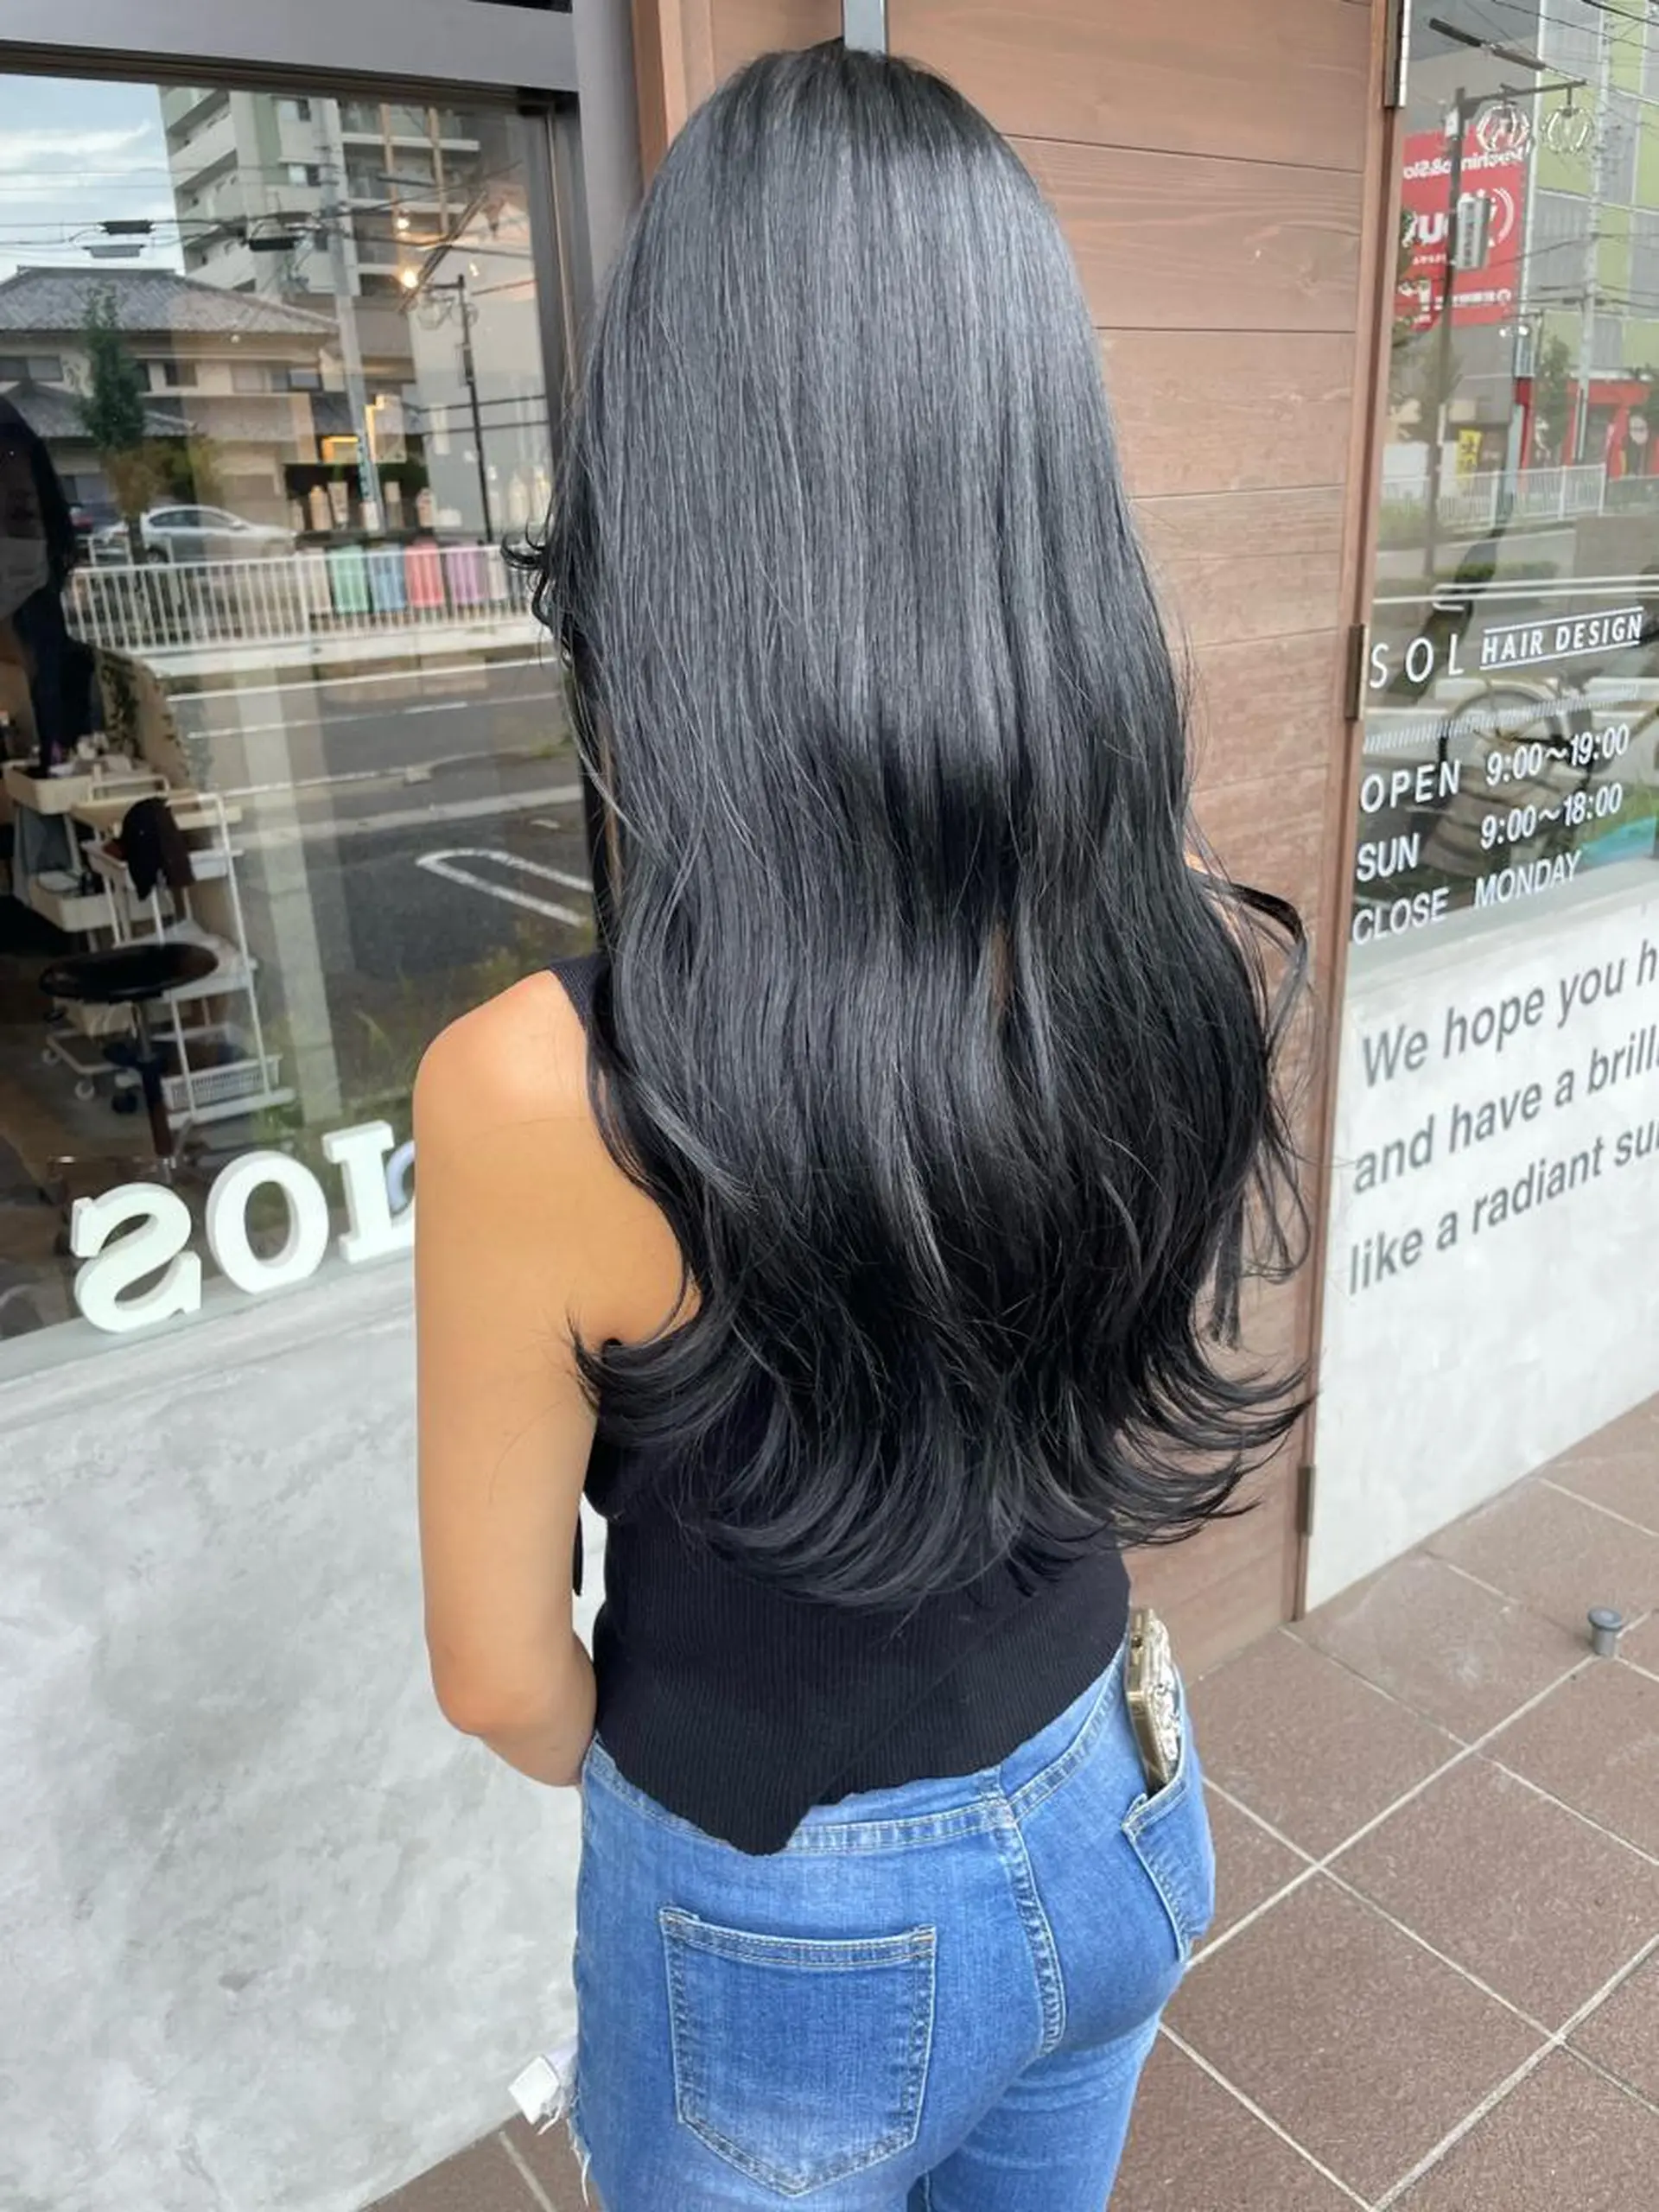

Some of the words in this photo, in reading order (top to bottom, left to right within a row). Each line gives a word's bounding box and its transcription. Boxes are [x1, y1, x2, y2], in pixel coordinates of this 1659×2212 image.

[1370, 634, 1464, 689] SOL
[1482, 630, 1543, 664] HAIR
[1555, 613, 1643, 652] DESIGN
[1360, 759, 1460, 813] OPEN
[1352, 886, 1449, 945] CLOSE
[1474, 849, 1582, 909] MONDAY
[1357, 832, 1420, 882] SUN
[1363, 1024, 1428, 1088] We
[1443, 987, 1545, 1058] hope
[1557, 957, 1625, 1028] you
[1354, 1114, 1434, 1194] and
[1449, 1083, 1542, 1154] have
[1554, 1069, 1574, 1108] a
[1586, 1023, 1659, 1095] brill
[1350, 1228, 1423, 1295] like
[1436, 1211, 1458, 1251] a
[1472, 1136, 1605, 1235] radiant
[1614, 1121, 1659, 1167] su
